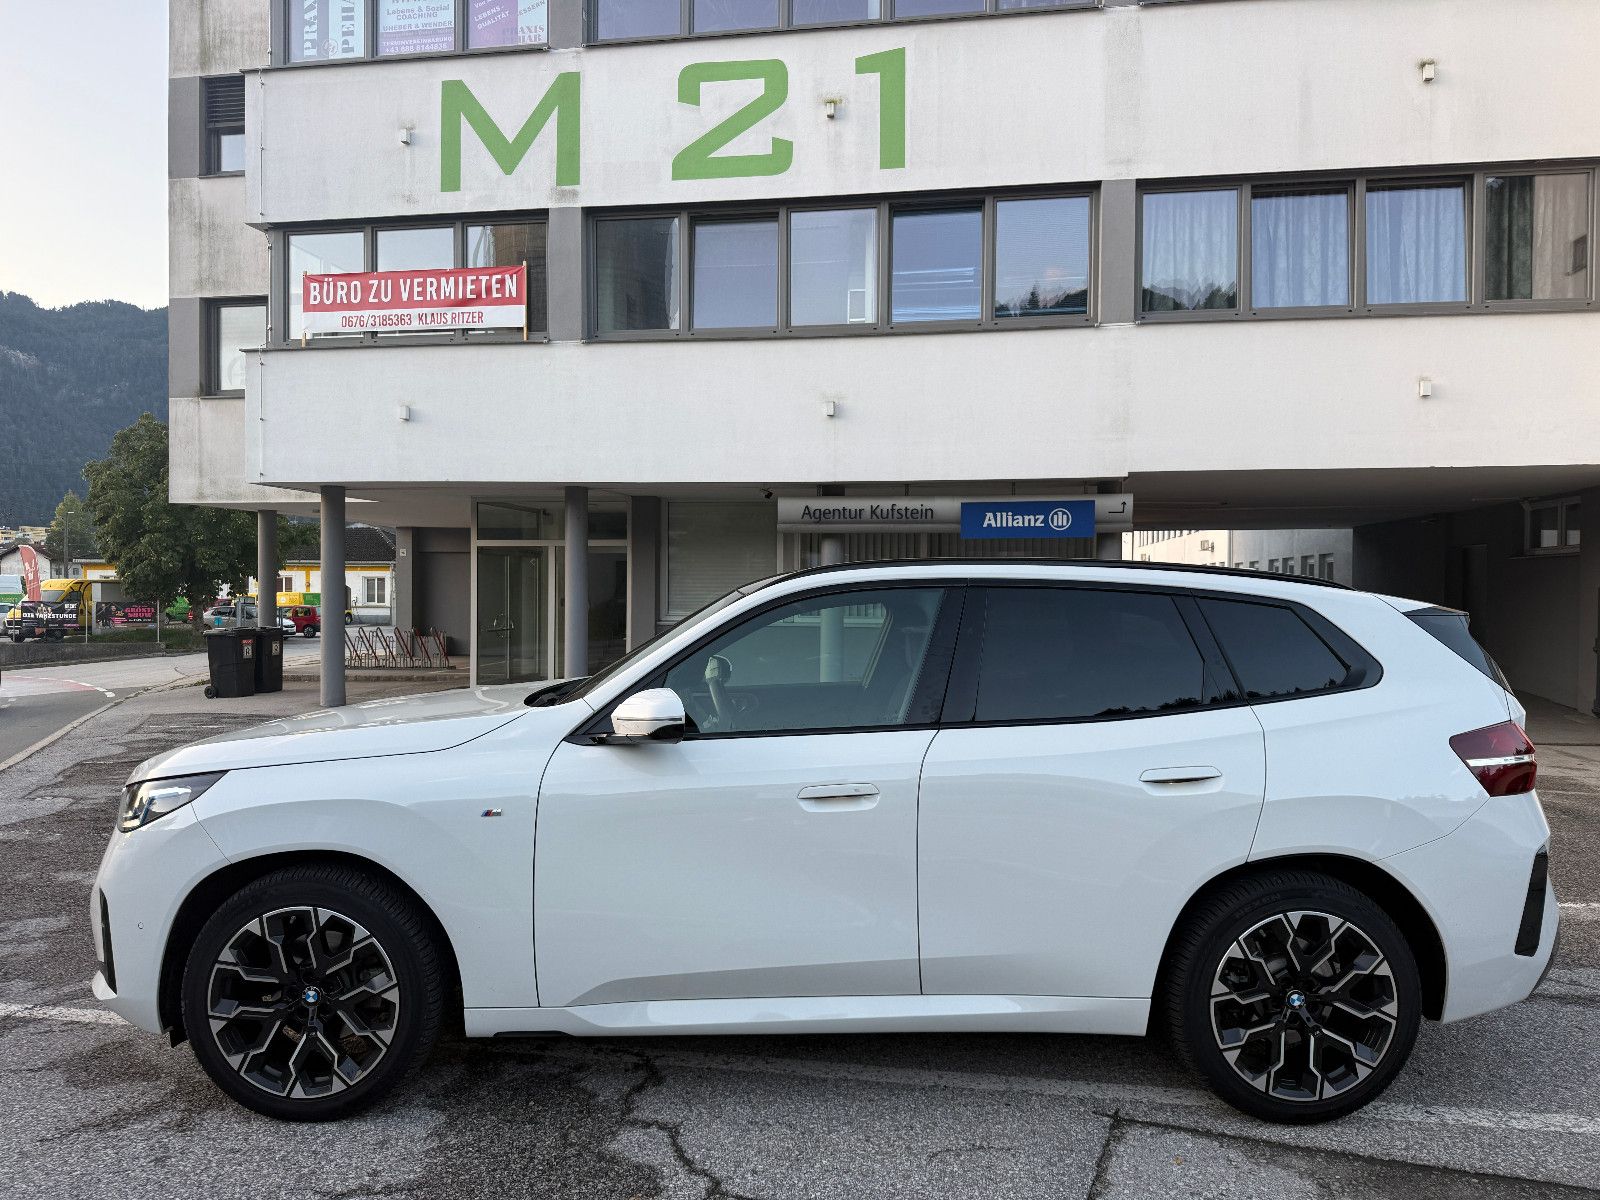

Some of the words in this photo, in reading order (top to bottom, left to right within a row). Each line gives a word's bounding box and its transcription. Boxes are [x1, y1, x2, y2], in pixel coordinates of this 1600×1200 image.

[396, 11, 438, 21] COACHING
[421, 20, 453, 28] WENDER
[440, 71, 581, 193] M
[309, 278, 362, 305] BÜRO
[368, 279, 392, 303] ZU
[399, 273, 517, 302] VERMIETEN
[341, 312, 412, 328] 0676/3185363
[418, 312, 448, 326] KLAUS
[450, 311, 484, 324] RITZER
[801, 504, 865, 523] Agentur
[870, 503, 934, 520] Kufstein
[982, 511, 1045, 528] Allianz
